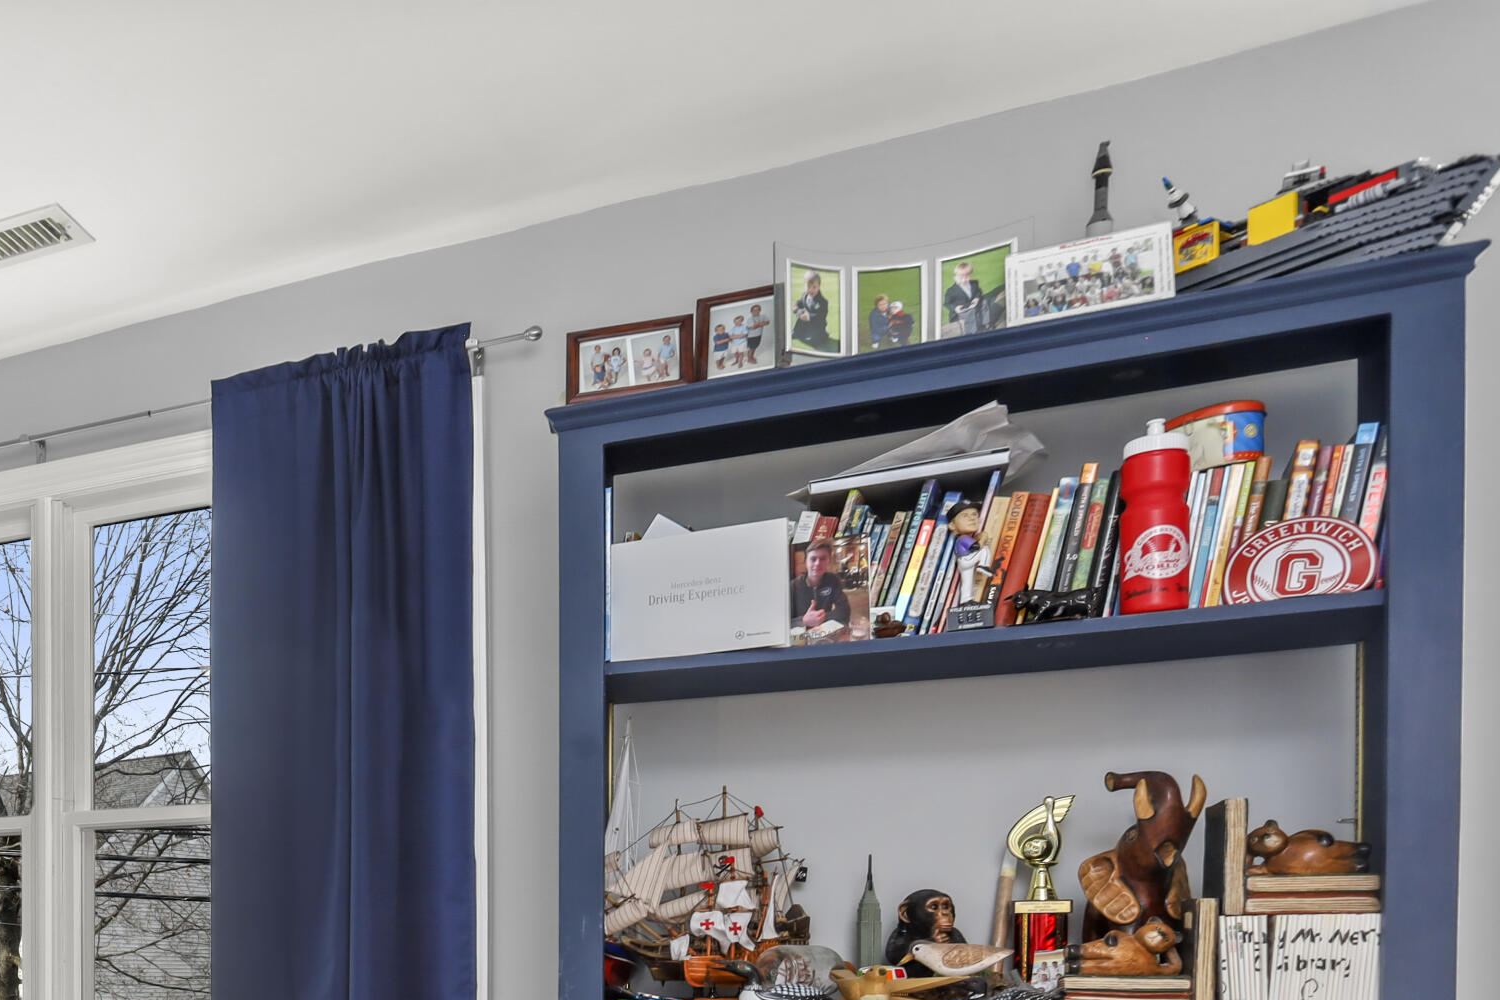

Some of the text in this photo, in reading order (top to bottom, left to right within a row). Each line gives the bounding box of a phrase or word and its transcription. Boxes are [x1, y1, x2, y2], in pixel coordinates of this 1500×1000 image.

[1242, 521, 1363, 558] GREENWICH
[1272, 549, 1325, 598] G
[648, 584, 746, 607] Driving Experience
